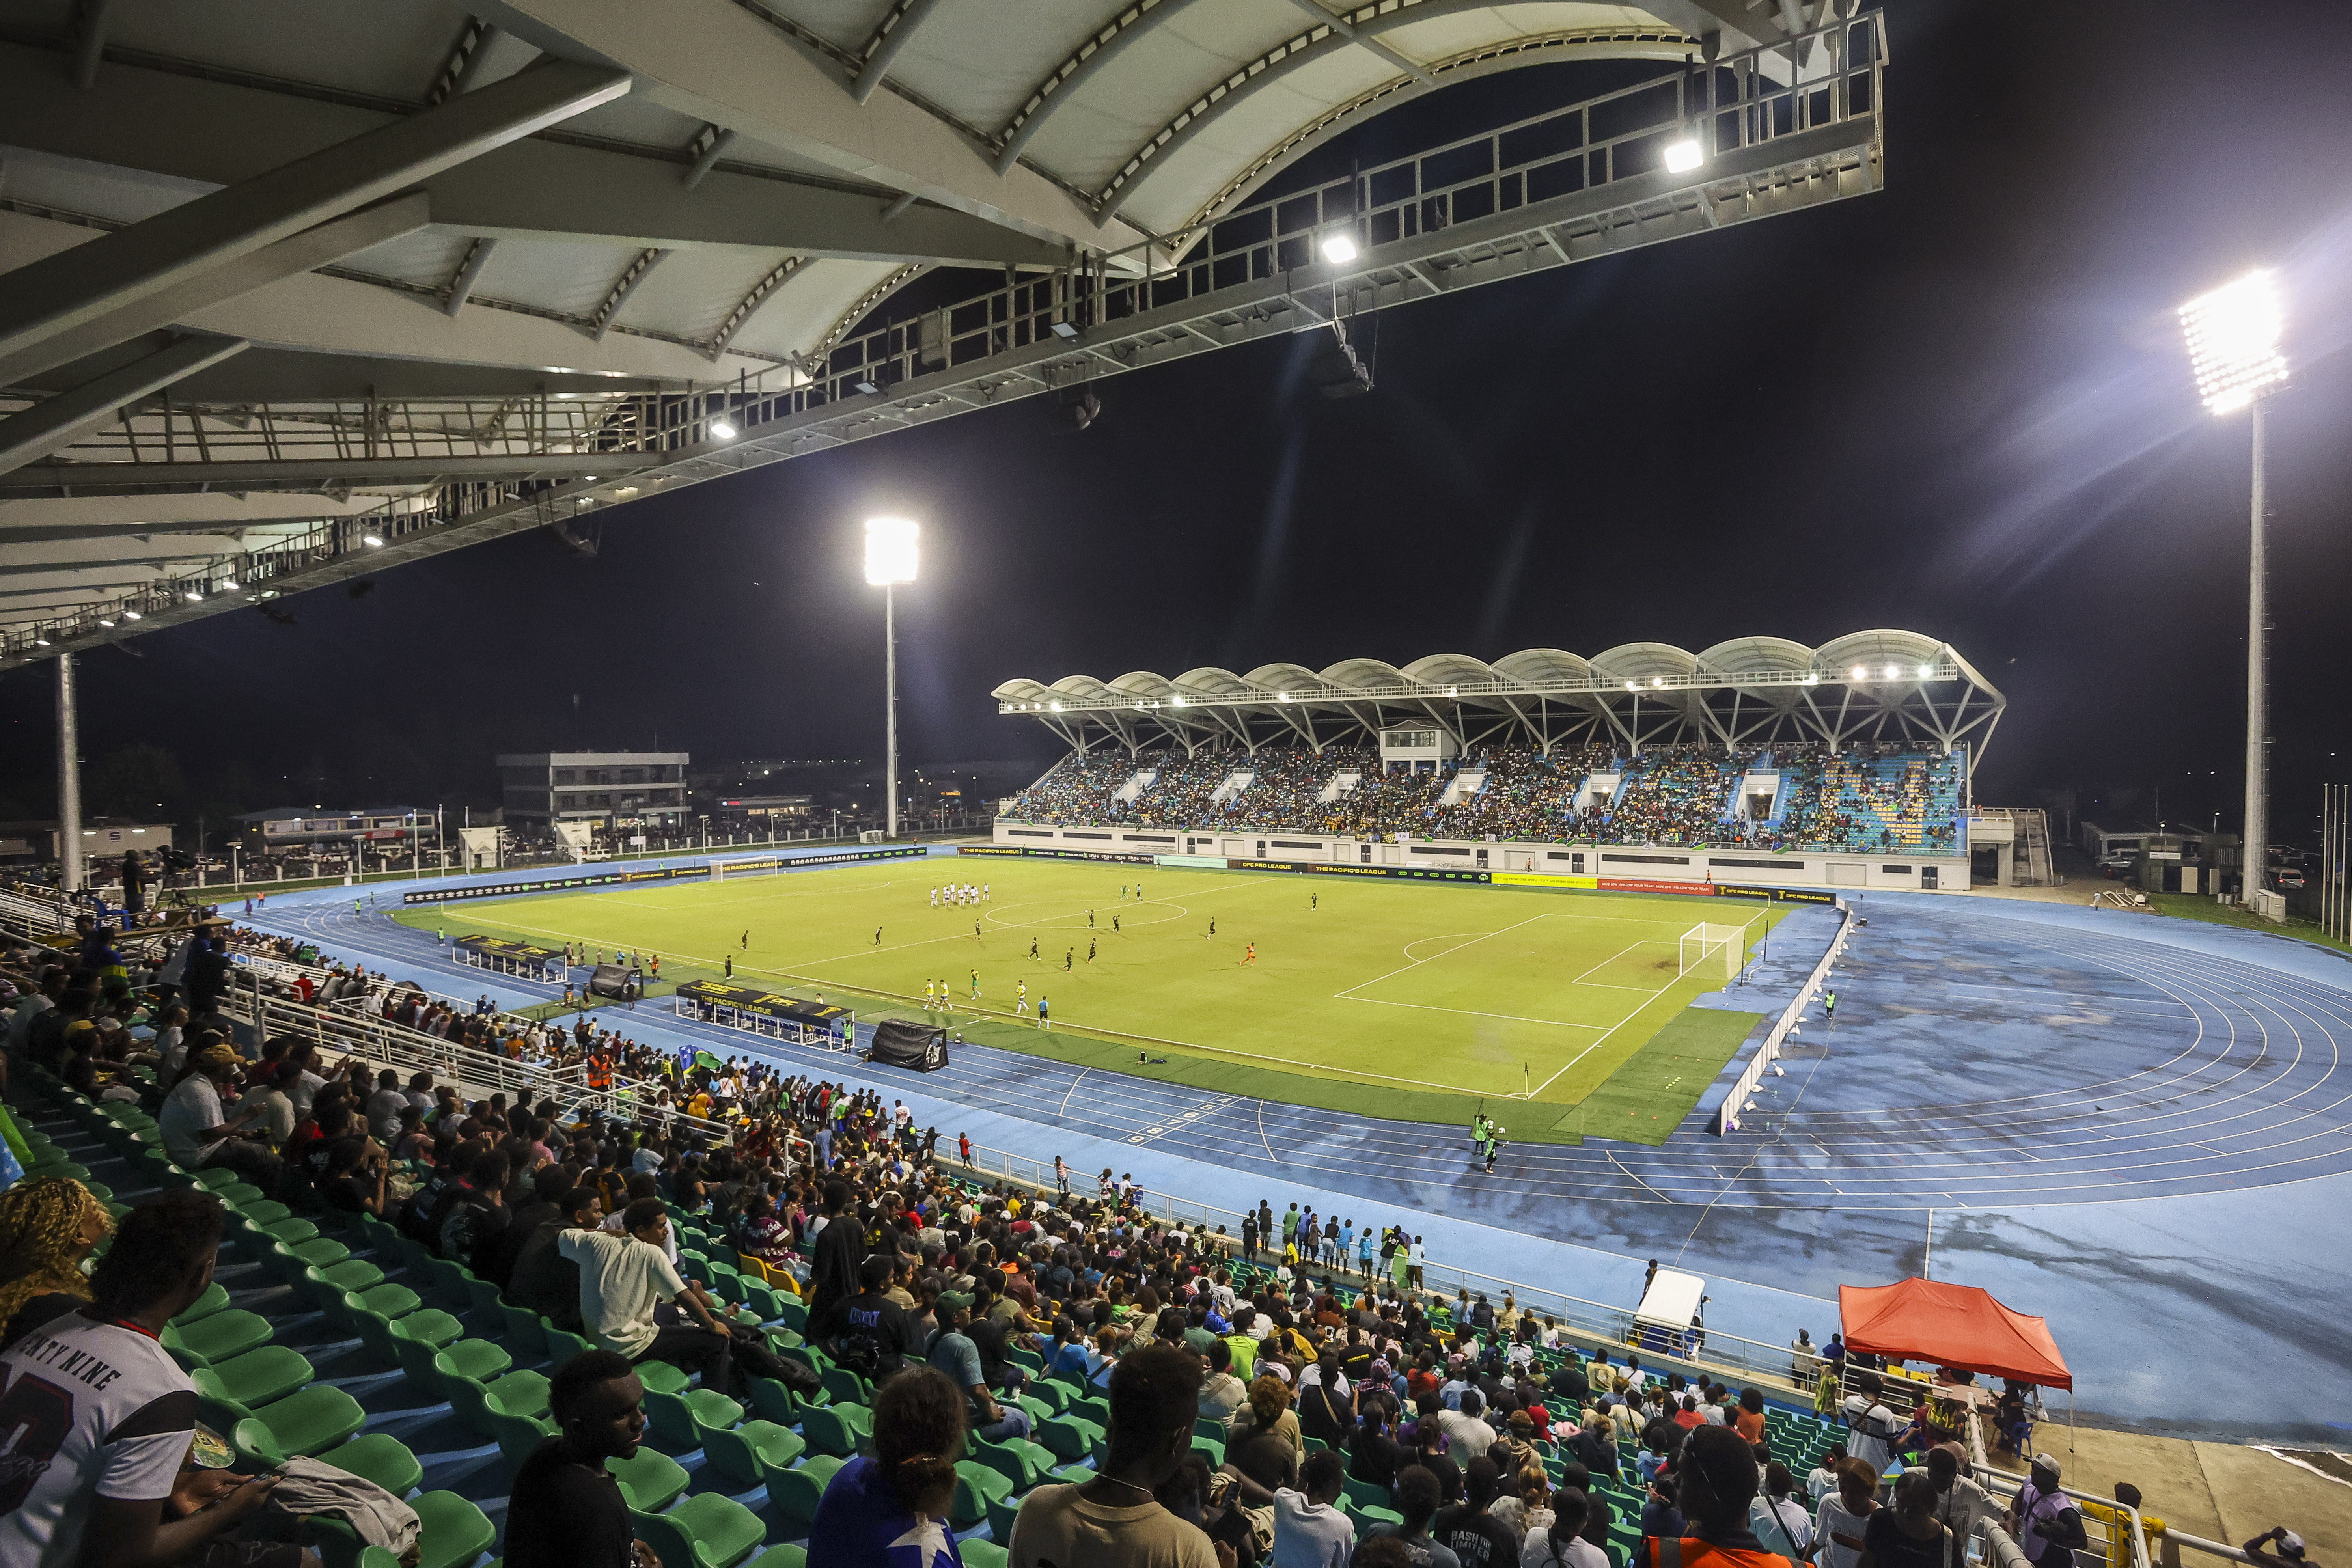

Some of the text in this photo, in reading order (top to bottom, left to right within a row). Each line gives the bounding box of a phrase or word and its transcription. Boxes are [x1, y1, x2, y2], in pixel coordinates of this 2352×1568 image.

[701, 995, 772, 1015] THE PACIFIC'S LEAGUE
[58, 1350, 122, 1391] NINE
[1451, 1531, 1479, 1544] BASH
[1451, 1540, 1490, 1561] LIMITER
